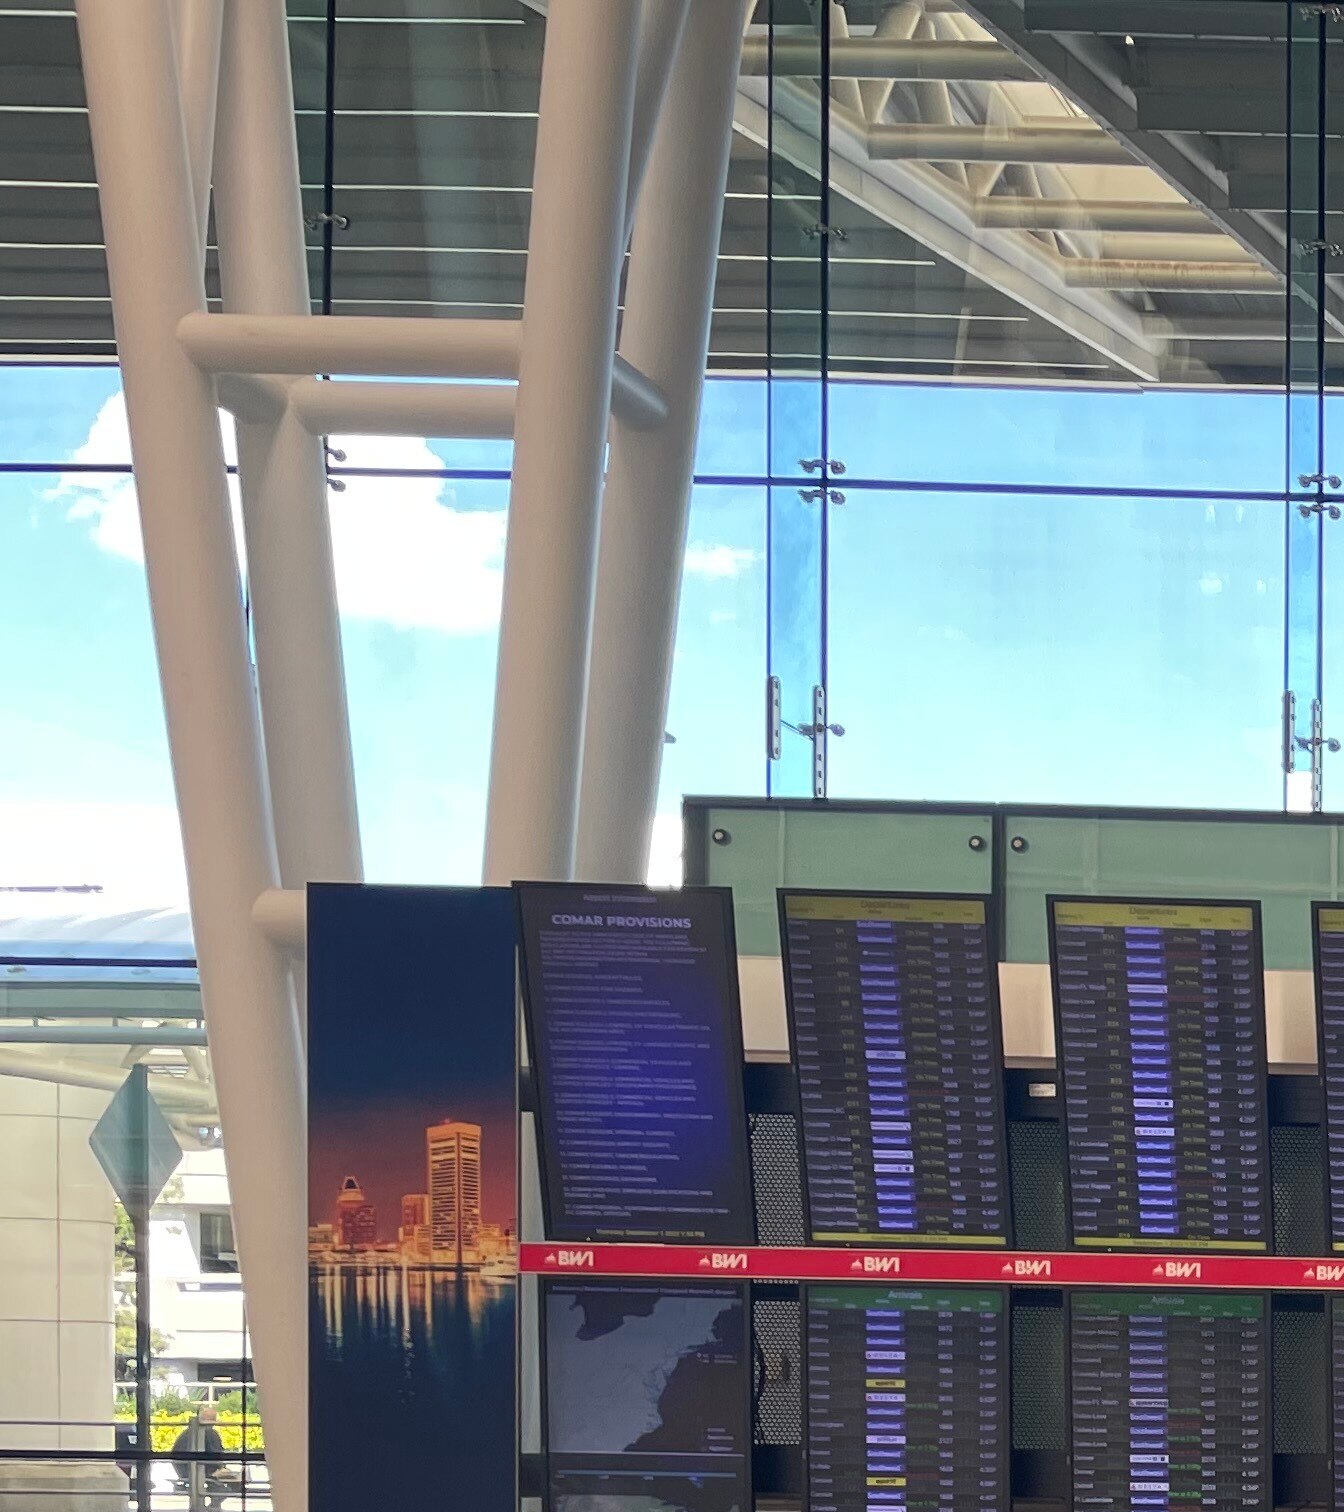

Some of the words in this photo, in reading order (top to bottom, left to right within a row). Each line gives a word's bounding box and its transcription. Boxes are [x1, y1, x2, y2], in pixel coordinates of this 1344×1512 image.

[551, 914, 603, 926] COMAR
[606, 916, 692, 929] PROVISIONS
[558, 1251, 594, 1267] BWI
[711, 1253, 748, 1269] BWI
[863, 1257, 900, 1273] BWI
[1014, 1260, 1051, 1276] BWI
[1165, 1262, 1202, 1279] BWI
